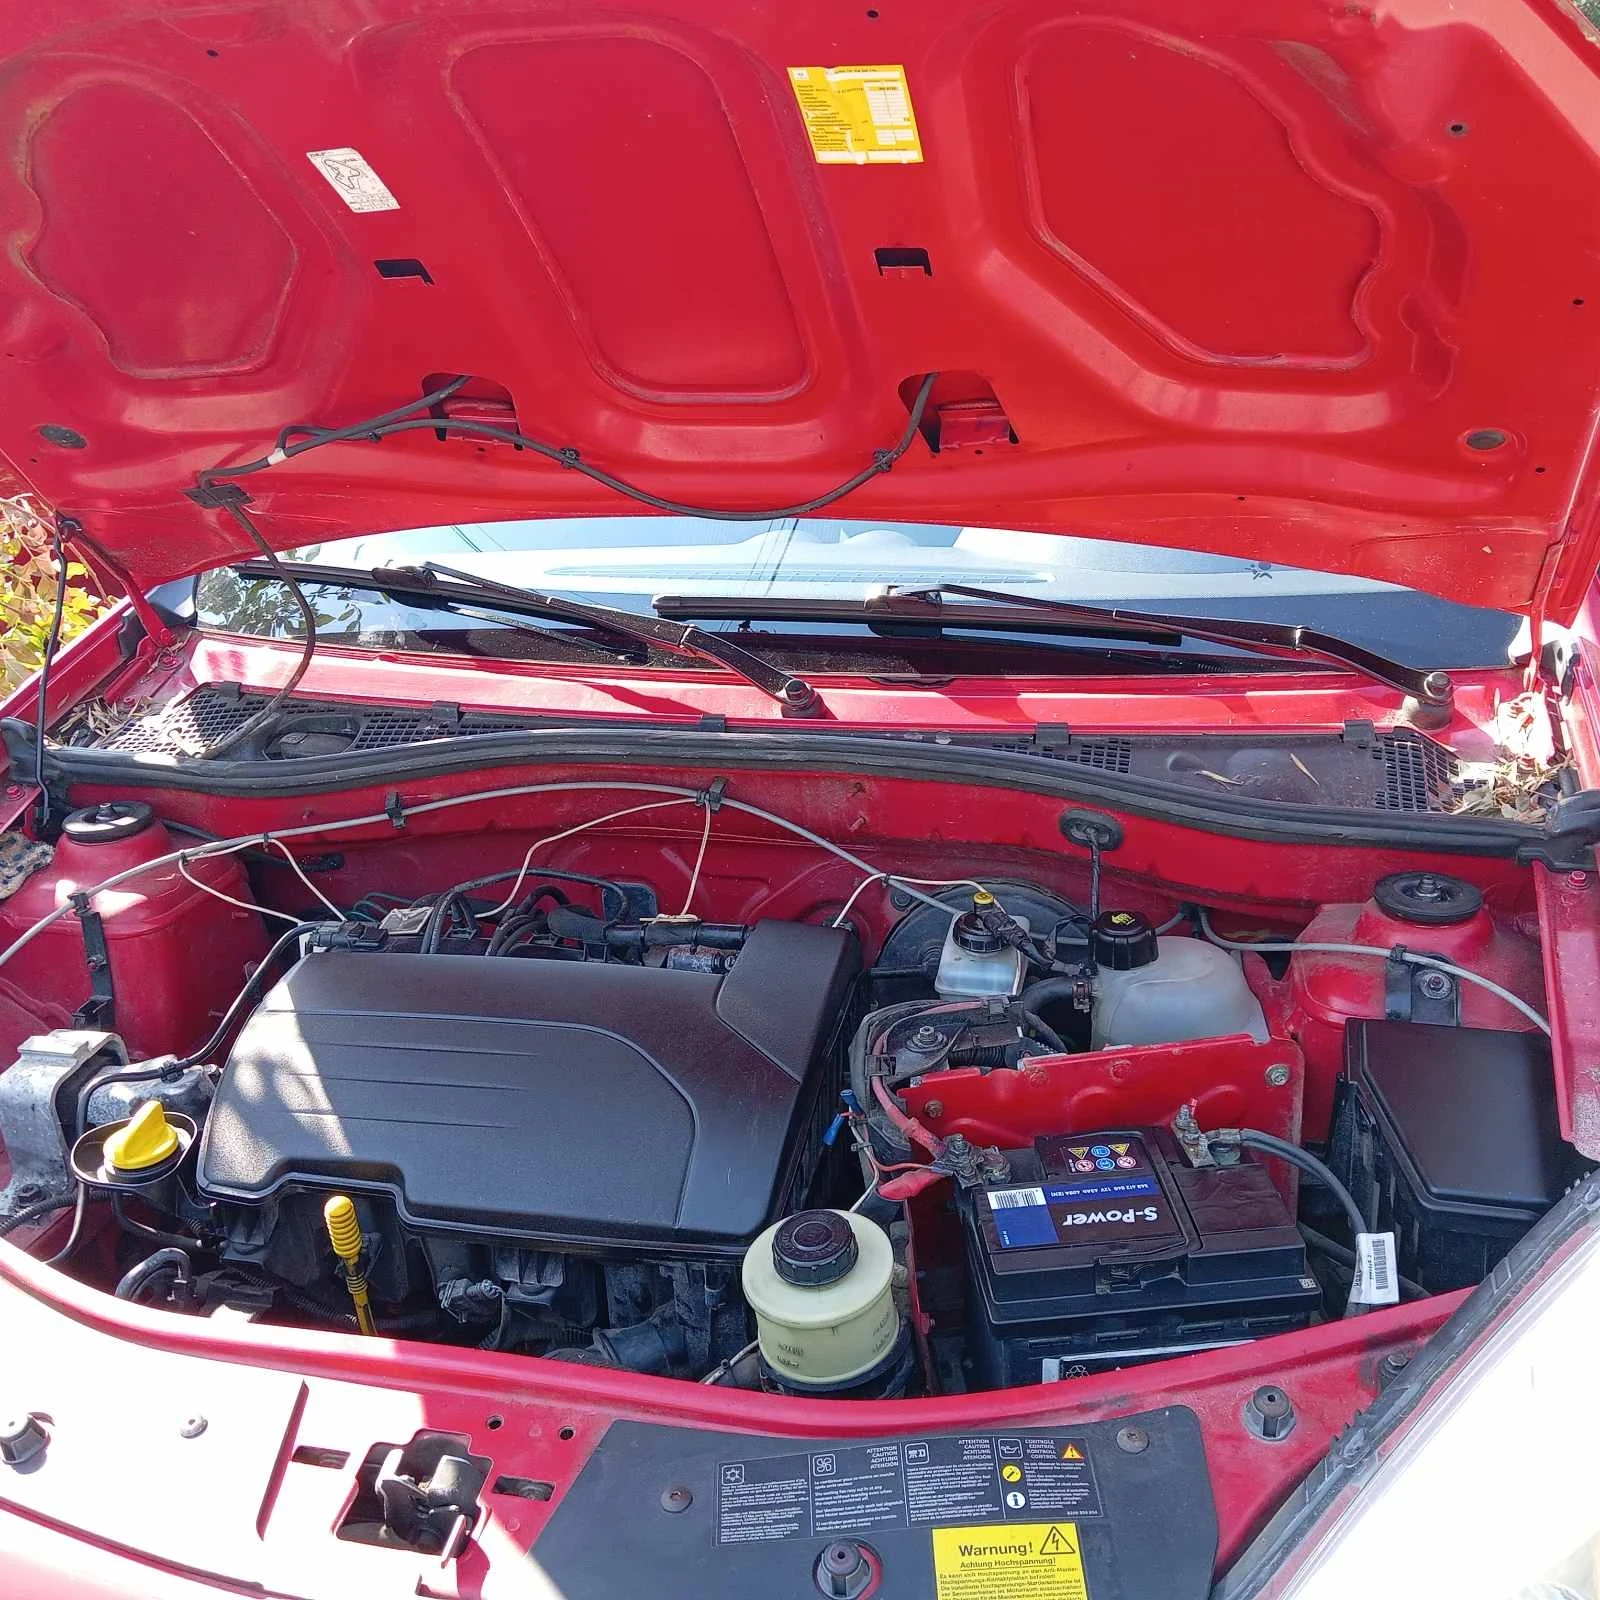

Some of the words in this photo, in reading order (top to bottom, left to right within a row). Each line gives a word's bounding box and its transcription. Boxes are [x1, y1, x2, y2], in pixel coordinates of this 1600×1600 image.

[1062, 1206, 1158, 1226] S-Power
[866, 1445, 898, 1454] ATTENTION
[872, 1450, 898, 1458] CAUTION
[871, 1455, 898, 1463] ACHTUNG
[958, 1541, 1033, 1557] Warnung!
[960, 1560, 993, 1568] Achtung
[994, 1557, 1056, 1567] Hochspannung!
